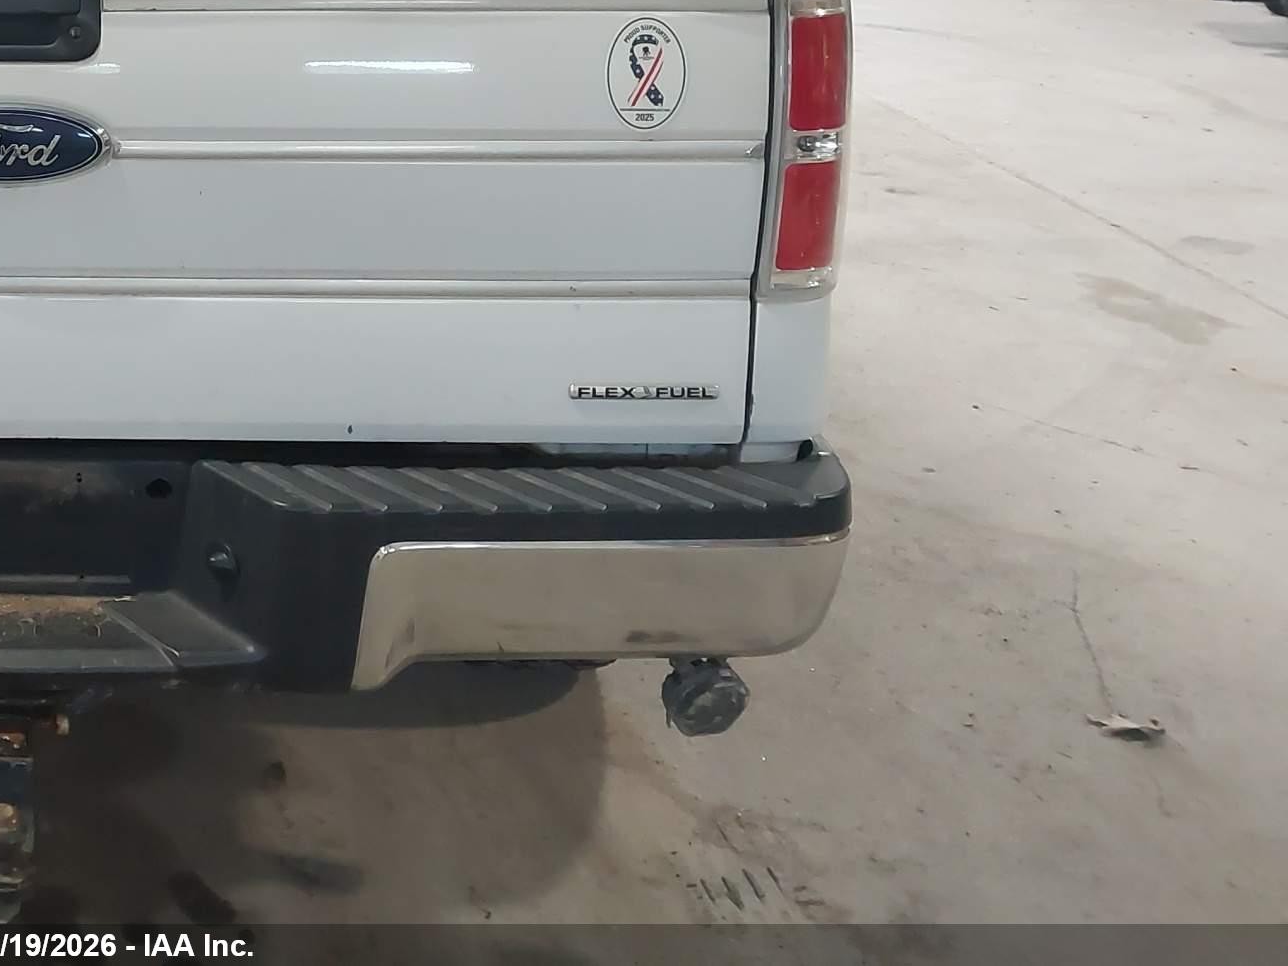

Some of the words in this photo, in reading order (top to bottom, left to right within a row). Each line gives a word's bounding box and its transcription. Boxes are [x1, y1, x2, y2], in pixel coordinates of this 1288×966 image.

[624, 27, 640, 43] PROUD
[640, 25, 671, 43] SUPPORTER
[635, 113, 655, 122] 2025
[577, 386, 636, 399] FLEX
[655, 386, 713, 399] FUEL
